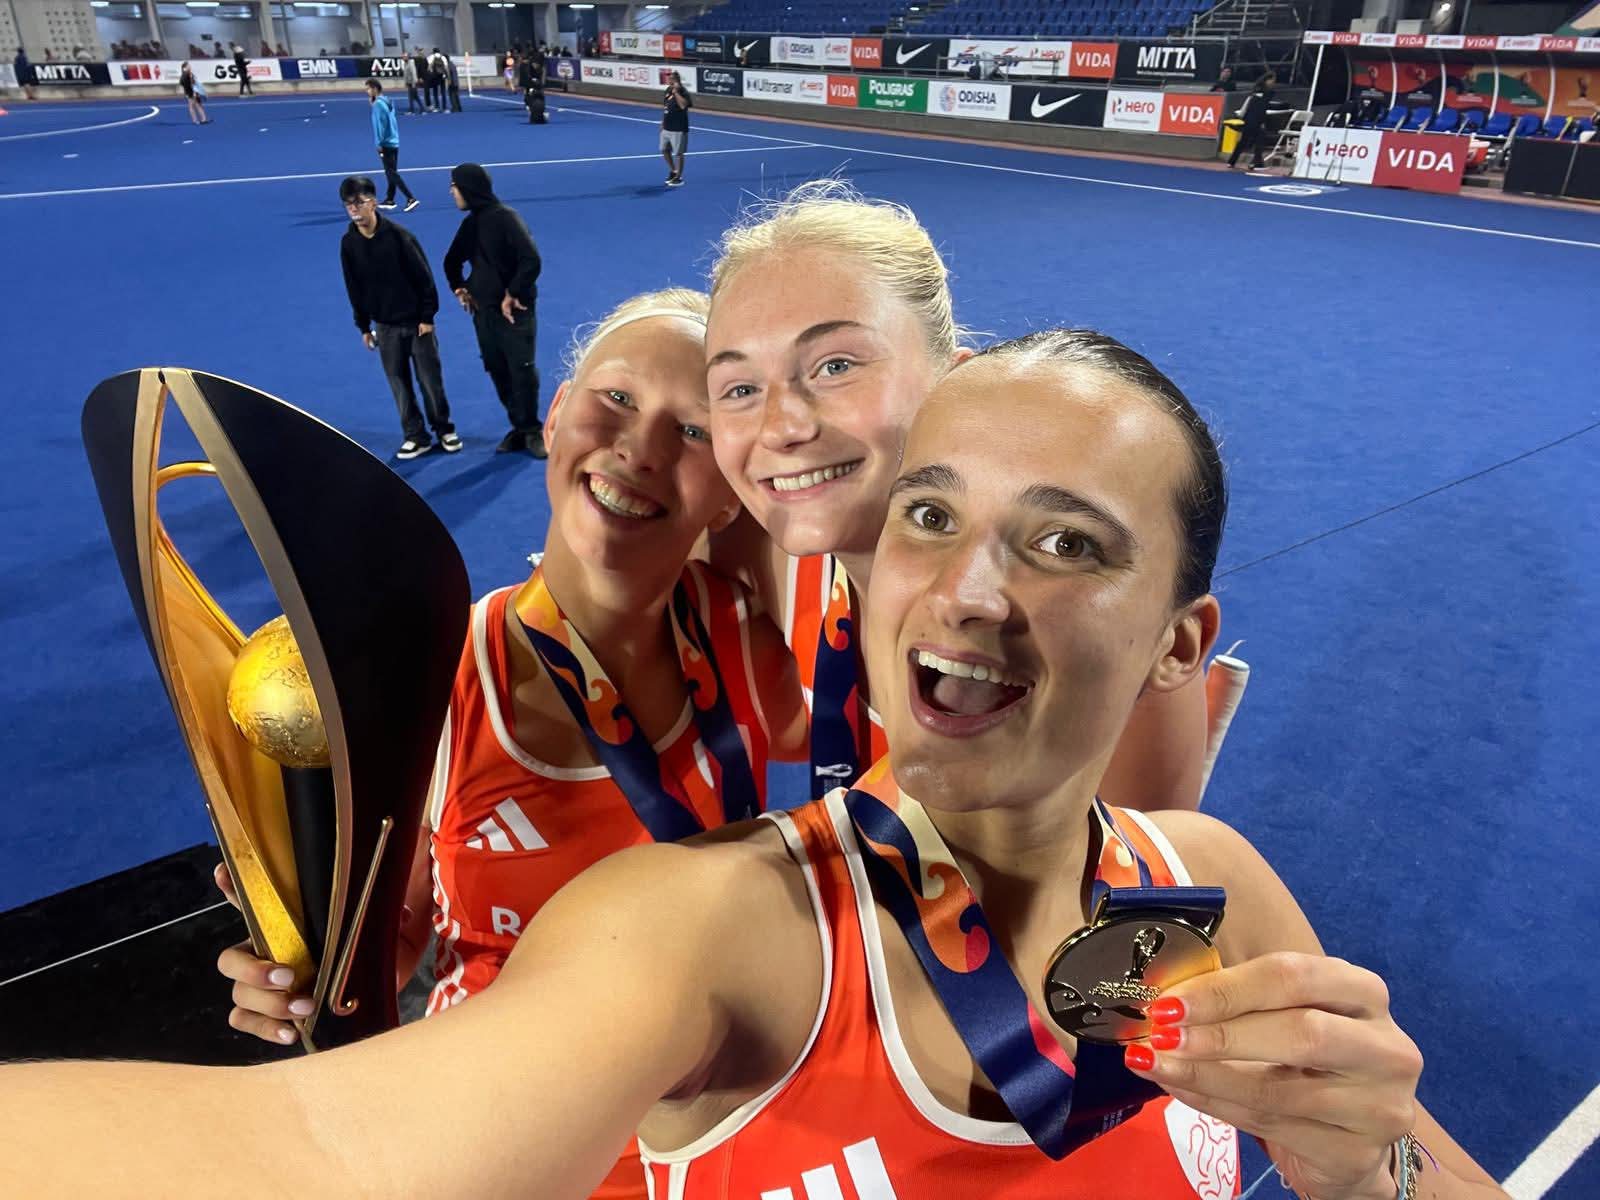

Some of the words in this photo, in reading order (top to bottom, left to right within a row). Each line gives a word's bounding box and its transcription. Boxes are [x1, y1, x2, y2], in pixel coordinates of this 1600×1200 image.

[1334, 34, 1358, 43] VIDA
[1399, 36, 1424, 45] VIDA
[1467, 38, 1496, 47] VIDA
[1543, 39, 1574, 49] VIDA
[854, 46, 880, 59] VIDA
[1075, 52, 1111, 68] VIDA
[1136, 46, 1197, 70] MITTA
[35, 65, 91, 80] MITTA
[298, 59, 337, 74] EMIN
[758, 79, 793, 95] Ultramar
[830, 84, 856, 97] VIDA
[869, 80, 914, 97] POLIGRAS
[958, 90, 996, 105] ODISHA
[1168, 105, 1215, 124] VIDA
[1325, 143, 1369, 159] Hero
[1388, 148, 1454, 173] VIDA
